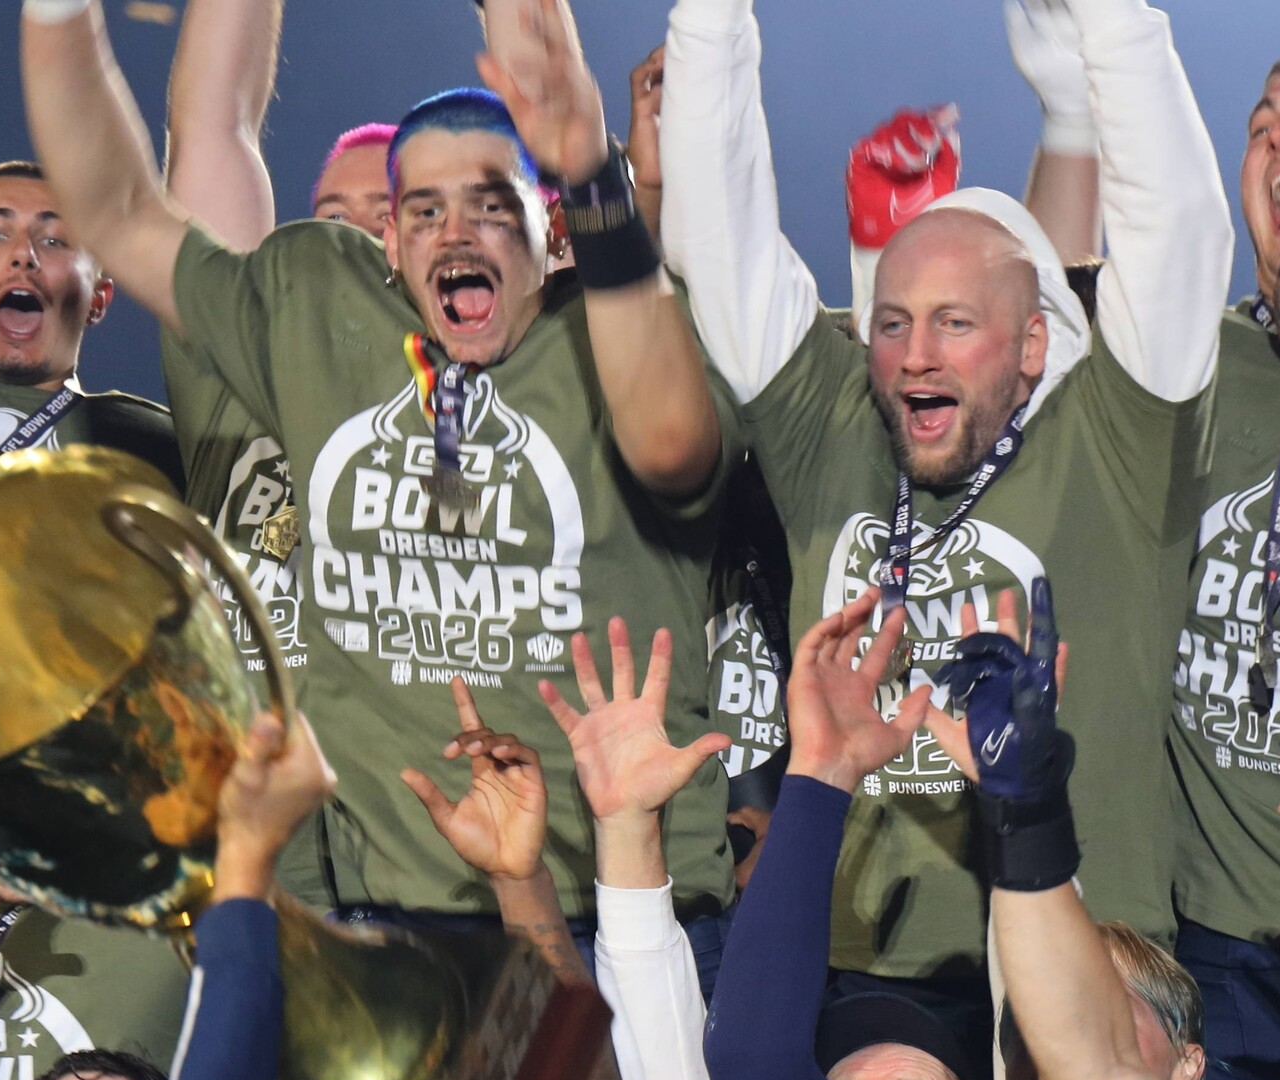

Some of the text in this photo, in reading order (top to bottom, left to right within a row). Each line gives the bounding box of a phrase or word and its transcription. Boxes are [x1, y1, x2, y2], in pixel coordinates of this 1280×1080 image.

[19, 411, 51, 439] BOWL
[46, 389, 73, 415] 2026
[968, 463, 997, 496] 2026
[351, 467, 528, 547] BOWL
[894, 504, 910, 536] 2026
[378, 528, 498, 563] DRESDEN
[313, 545, 584, 631] CHAMPS
[374, 606, 517, 672] 2026
